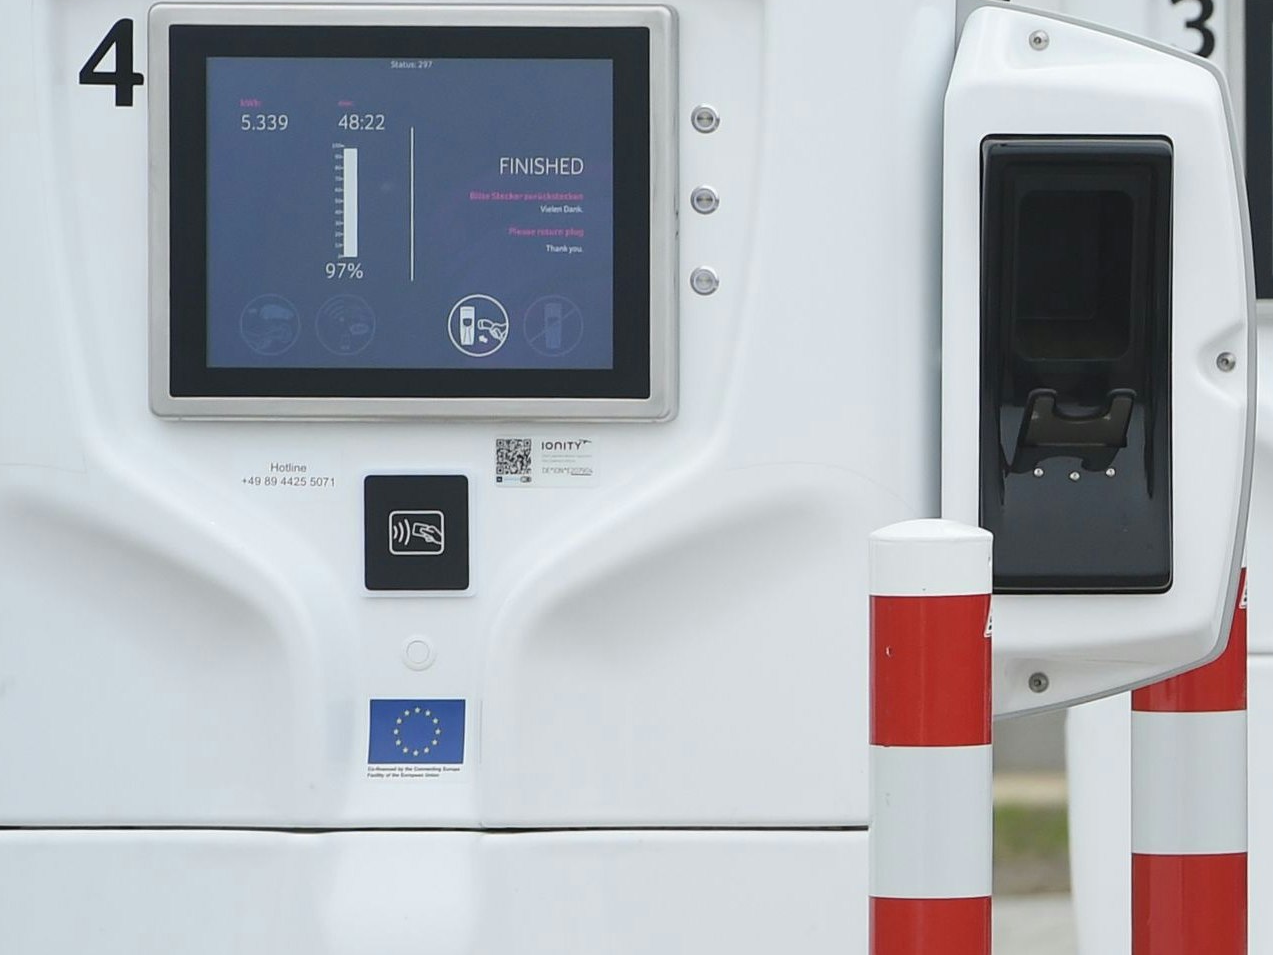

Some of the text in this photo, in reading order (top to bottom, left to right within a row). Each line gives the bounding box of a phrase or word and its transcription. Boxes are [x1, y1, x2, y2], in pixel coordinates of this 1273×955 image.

[79, 18, 144, 107] 4
[390, 60, 433, 69] Status: 297
[241, 114, 385, 131] 5.339 48:22
[500, 157, 584, 175] FINISHED
[540, 205, 562, 213] Vielen
[508, 227, 536, 236] Please
[565, 227, 584, 238] plug
[546, 244, 567, 253] Thank
[325, 262, 364, 279] 97%
[541, 441, 581, 451] IONITY
[270, 462, 307, 473] Hotline
[242, 476, 335, 487] +49 89 4425 5071
